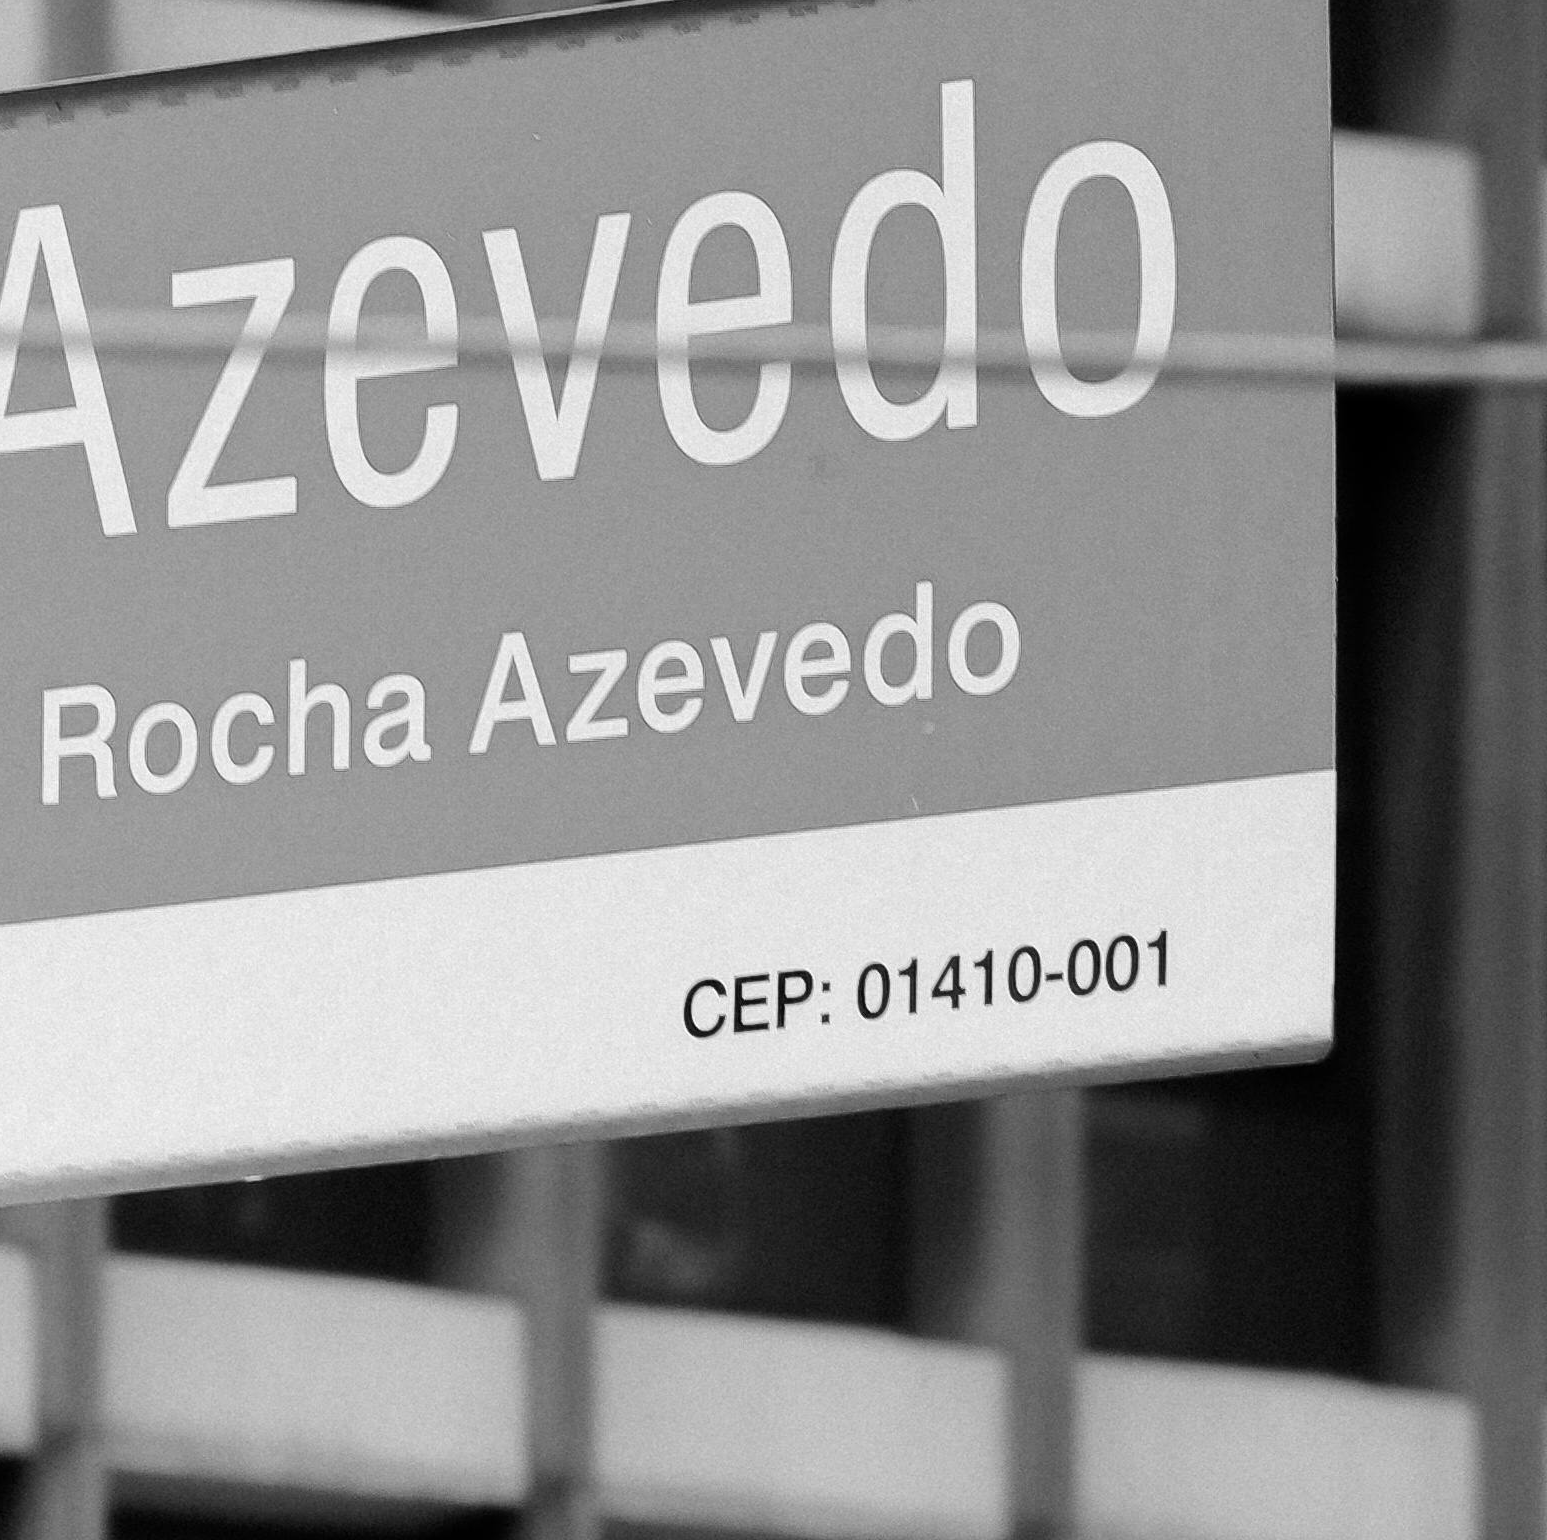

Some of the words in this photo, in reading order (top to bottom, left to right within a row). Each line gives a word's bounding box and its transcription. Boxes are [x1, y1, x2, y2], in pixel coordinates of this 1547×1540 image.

[41, 659, 432, 805] Rocha
[469, 581, 1021, 755] Azevedo
[682, 965, 833, 1040] CEP:
[856, 929, 1168, 1021] 01410-001
